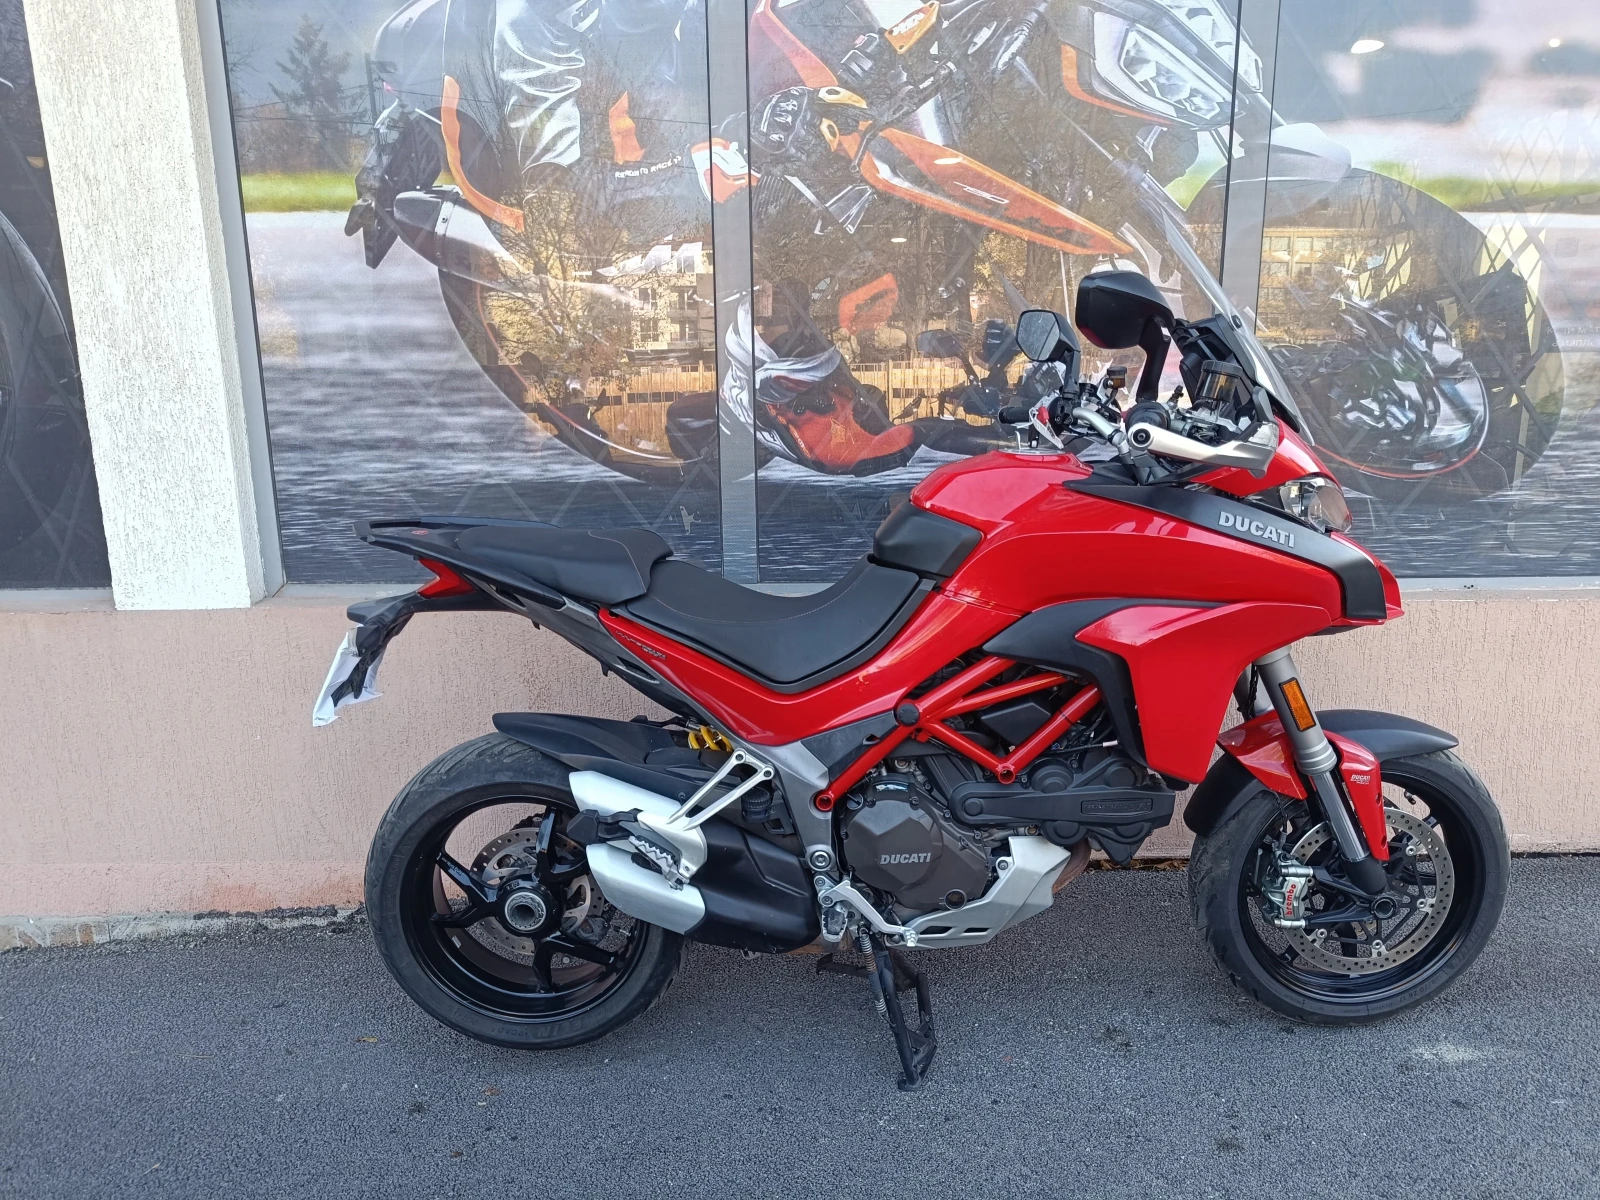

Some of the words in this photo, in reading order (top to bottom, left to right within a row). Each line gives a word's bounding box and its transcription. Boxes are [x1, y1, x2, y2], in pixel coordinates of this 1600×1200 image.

[1219, 511, 1295, 548] DUCATI
[1350, 774, 1371, 782] DUCATI
[880, 852, 931, 865] DUCATI
[1285, 883, 1297, 917] brembo
